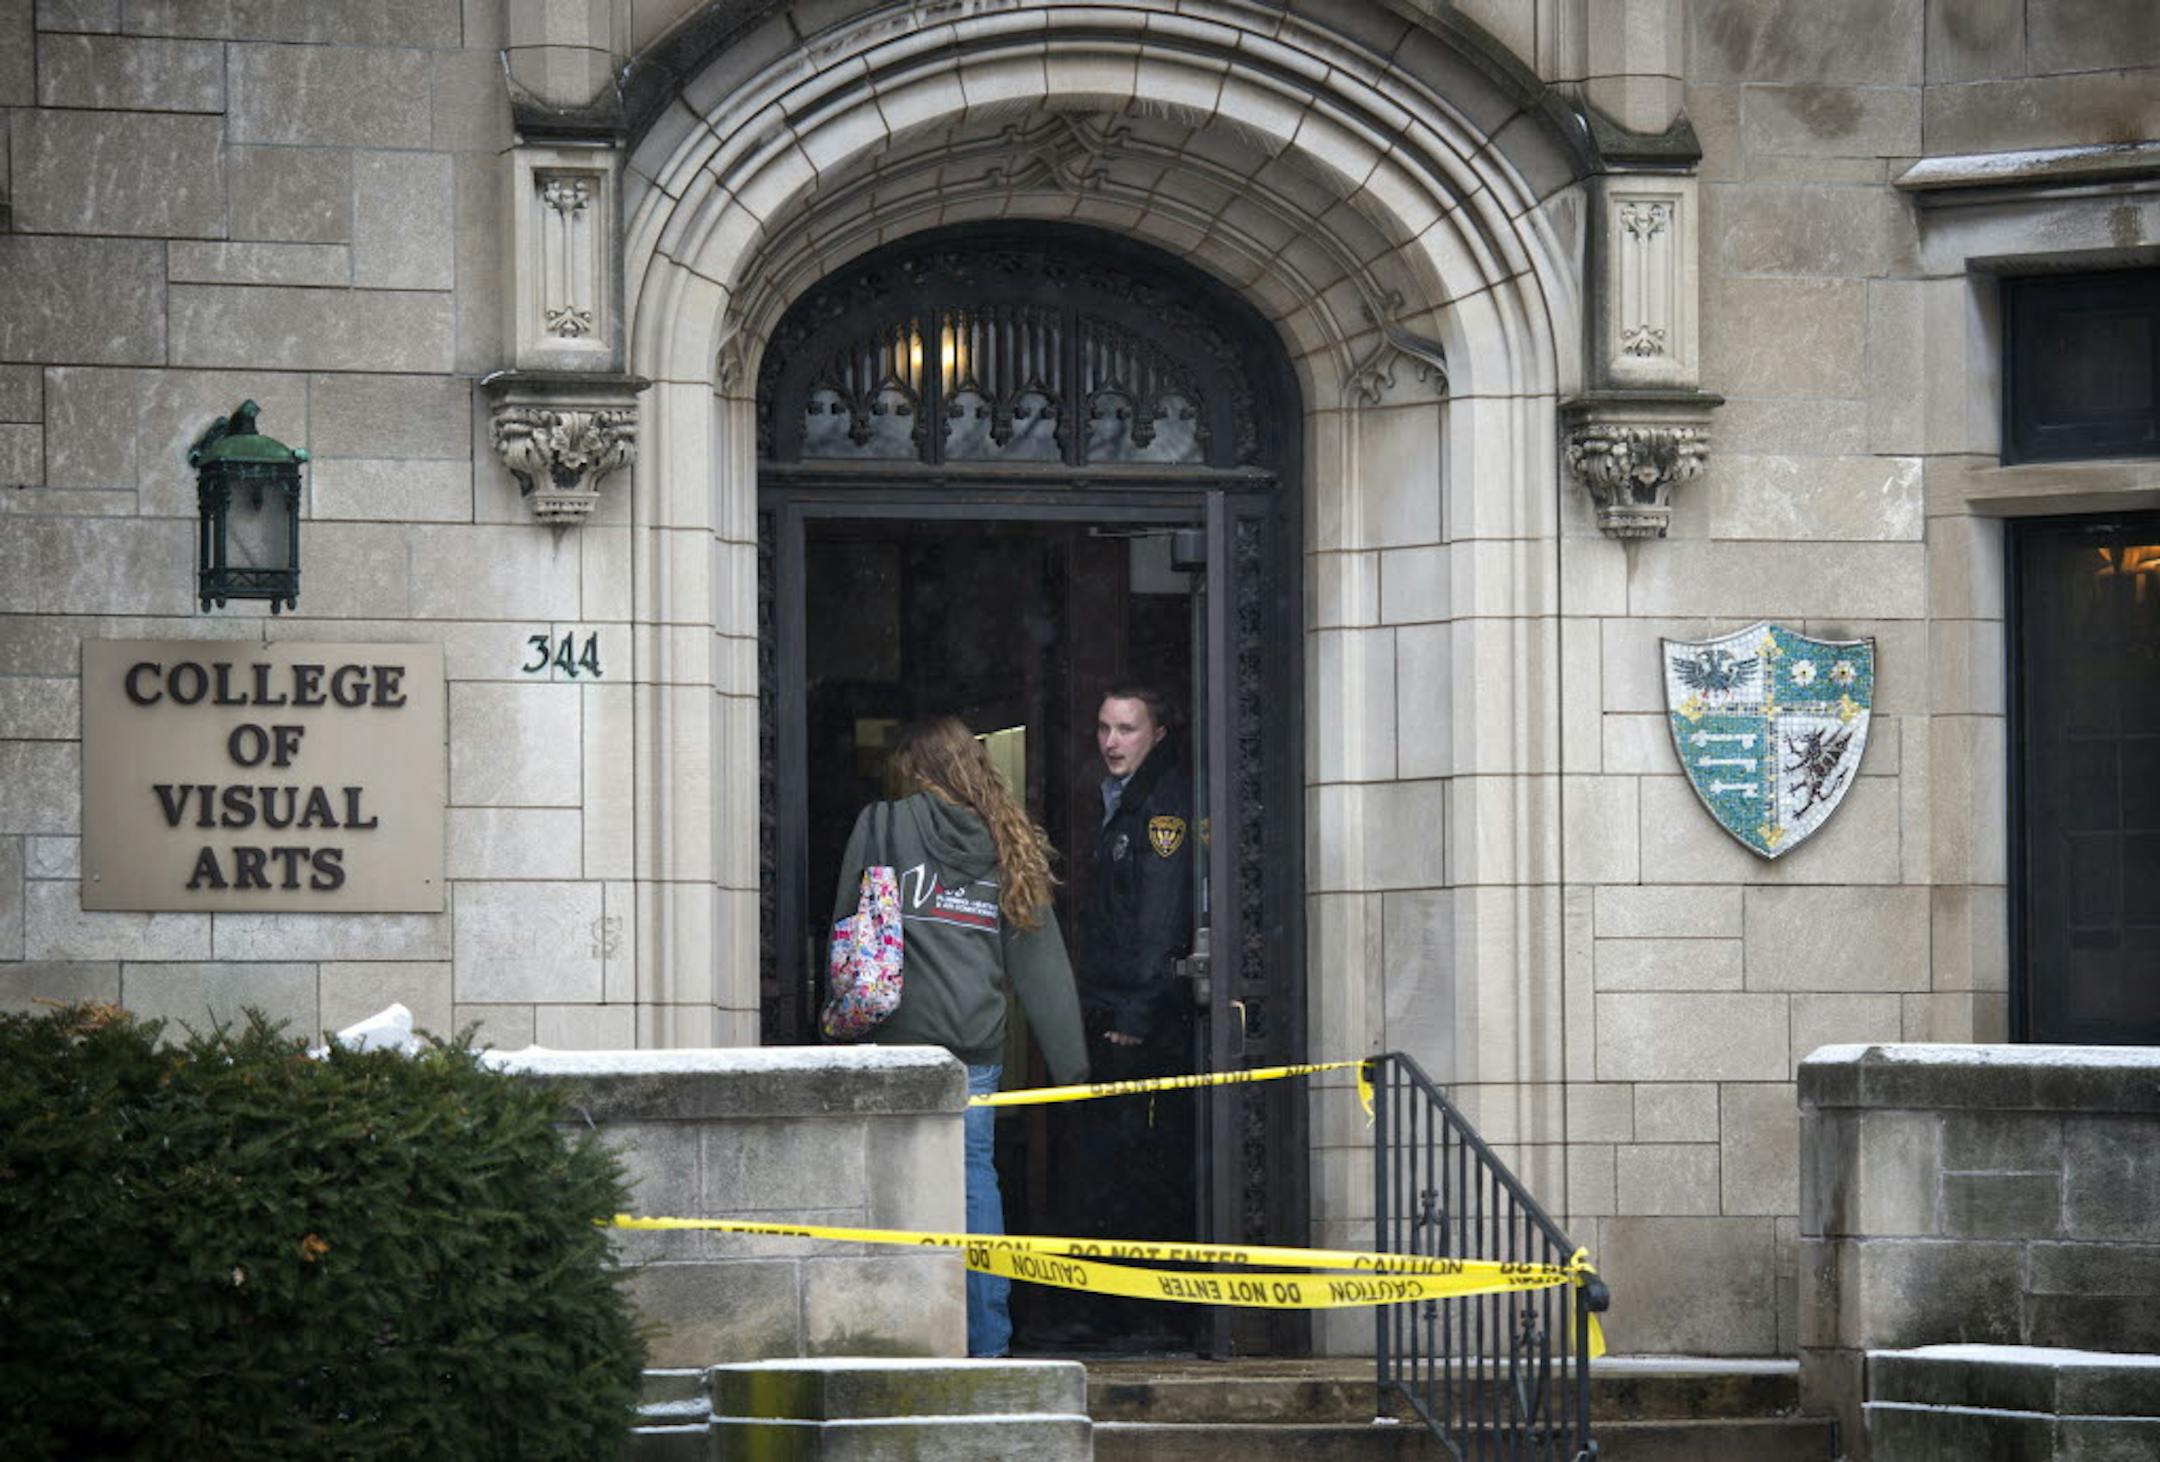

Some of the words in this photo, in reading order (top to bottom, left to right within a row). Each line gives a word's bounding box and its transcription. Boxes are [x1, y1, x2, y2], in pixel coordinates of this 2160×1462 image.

[522, 630, 604, 678] 344
[125, 661, 408, 708] COLLEGE
[227, 723, 305, 767] OF
[153, 784, 379, 830] VISUAL
[186, 846, 346, 891] ARTS
[1012, 1253, 1088, 1286] CAUTION
[1354, 1256, 1464, 1275] CAUTION
[1158, 1275, 1222, 1300] ENTER
[1229, 1280, 1269, 1304] NOT
[1273, 1282, 1303, 1304] DO
[1329, 1279, 1424, 1302] CAUTION
